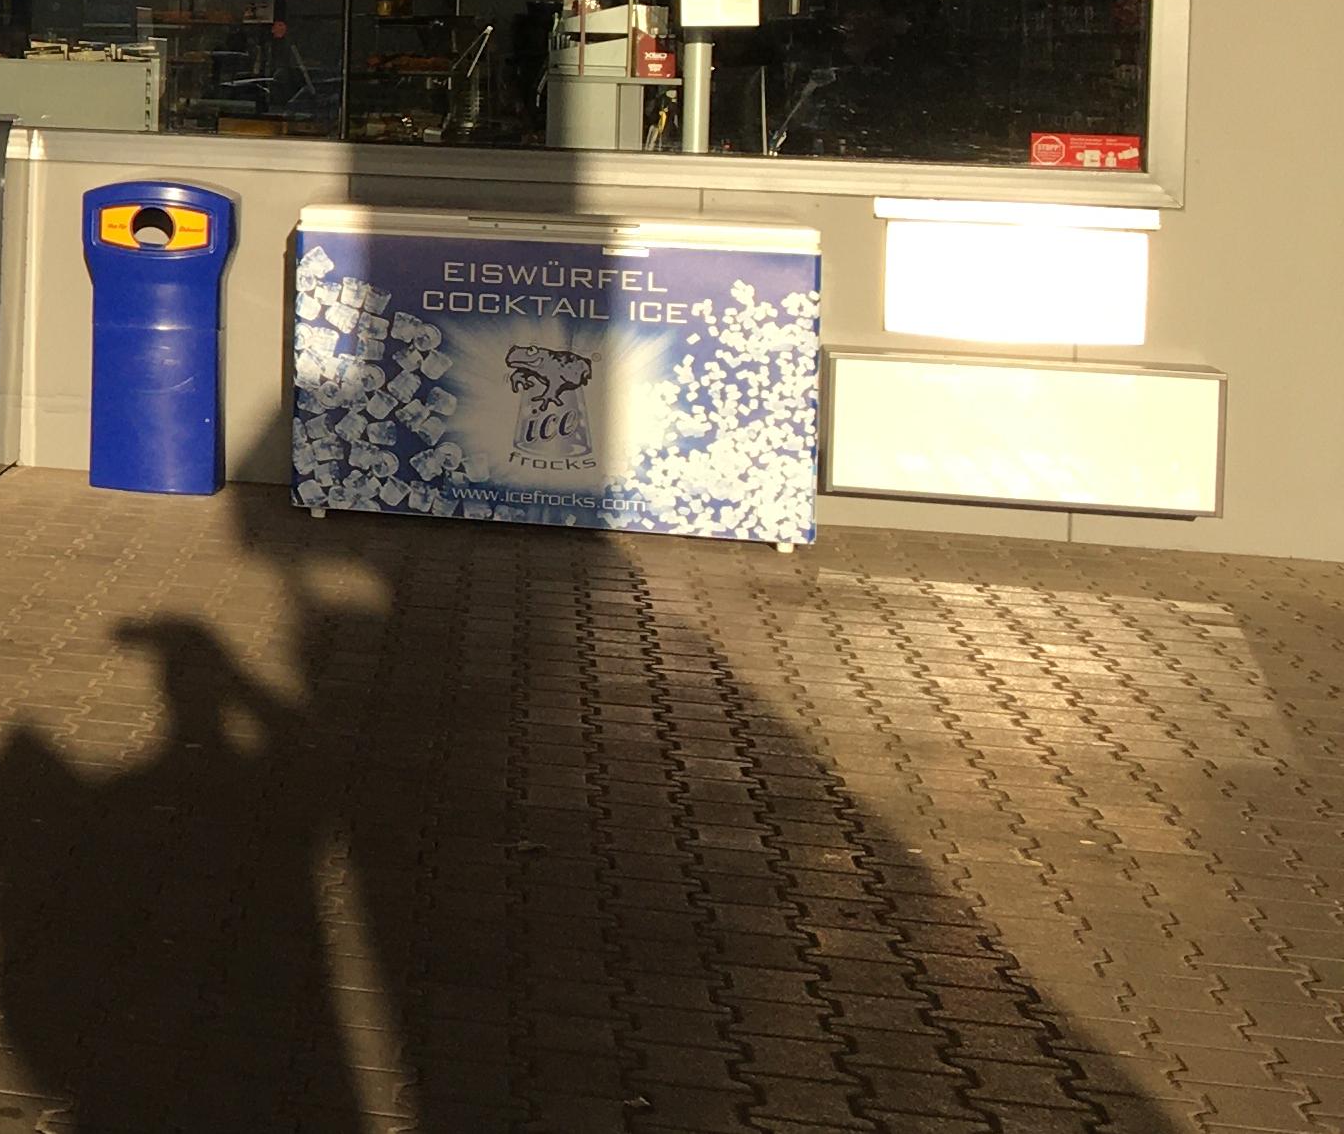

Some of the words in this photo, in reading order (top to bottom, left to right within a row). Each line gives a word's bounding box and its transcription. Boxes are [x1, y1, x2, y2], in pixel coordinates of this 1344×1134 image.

[443, 260, 668, 293] EISWÜRFEL
[423, 291, 609, 321] COCKTAIL
[629, 303, 689, 325] ICE
[525, 406, 580, 443] ice
[508, 450, 597, 471] frocks
[450, 485, 646, 513] www.icefrocks.com
